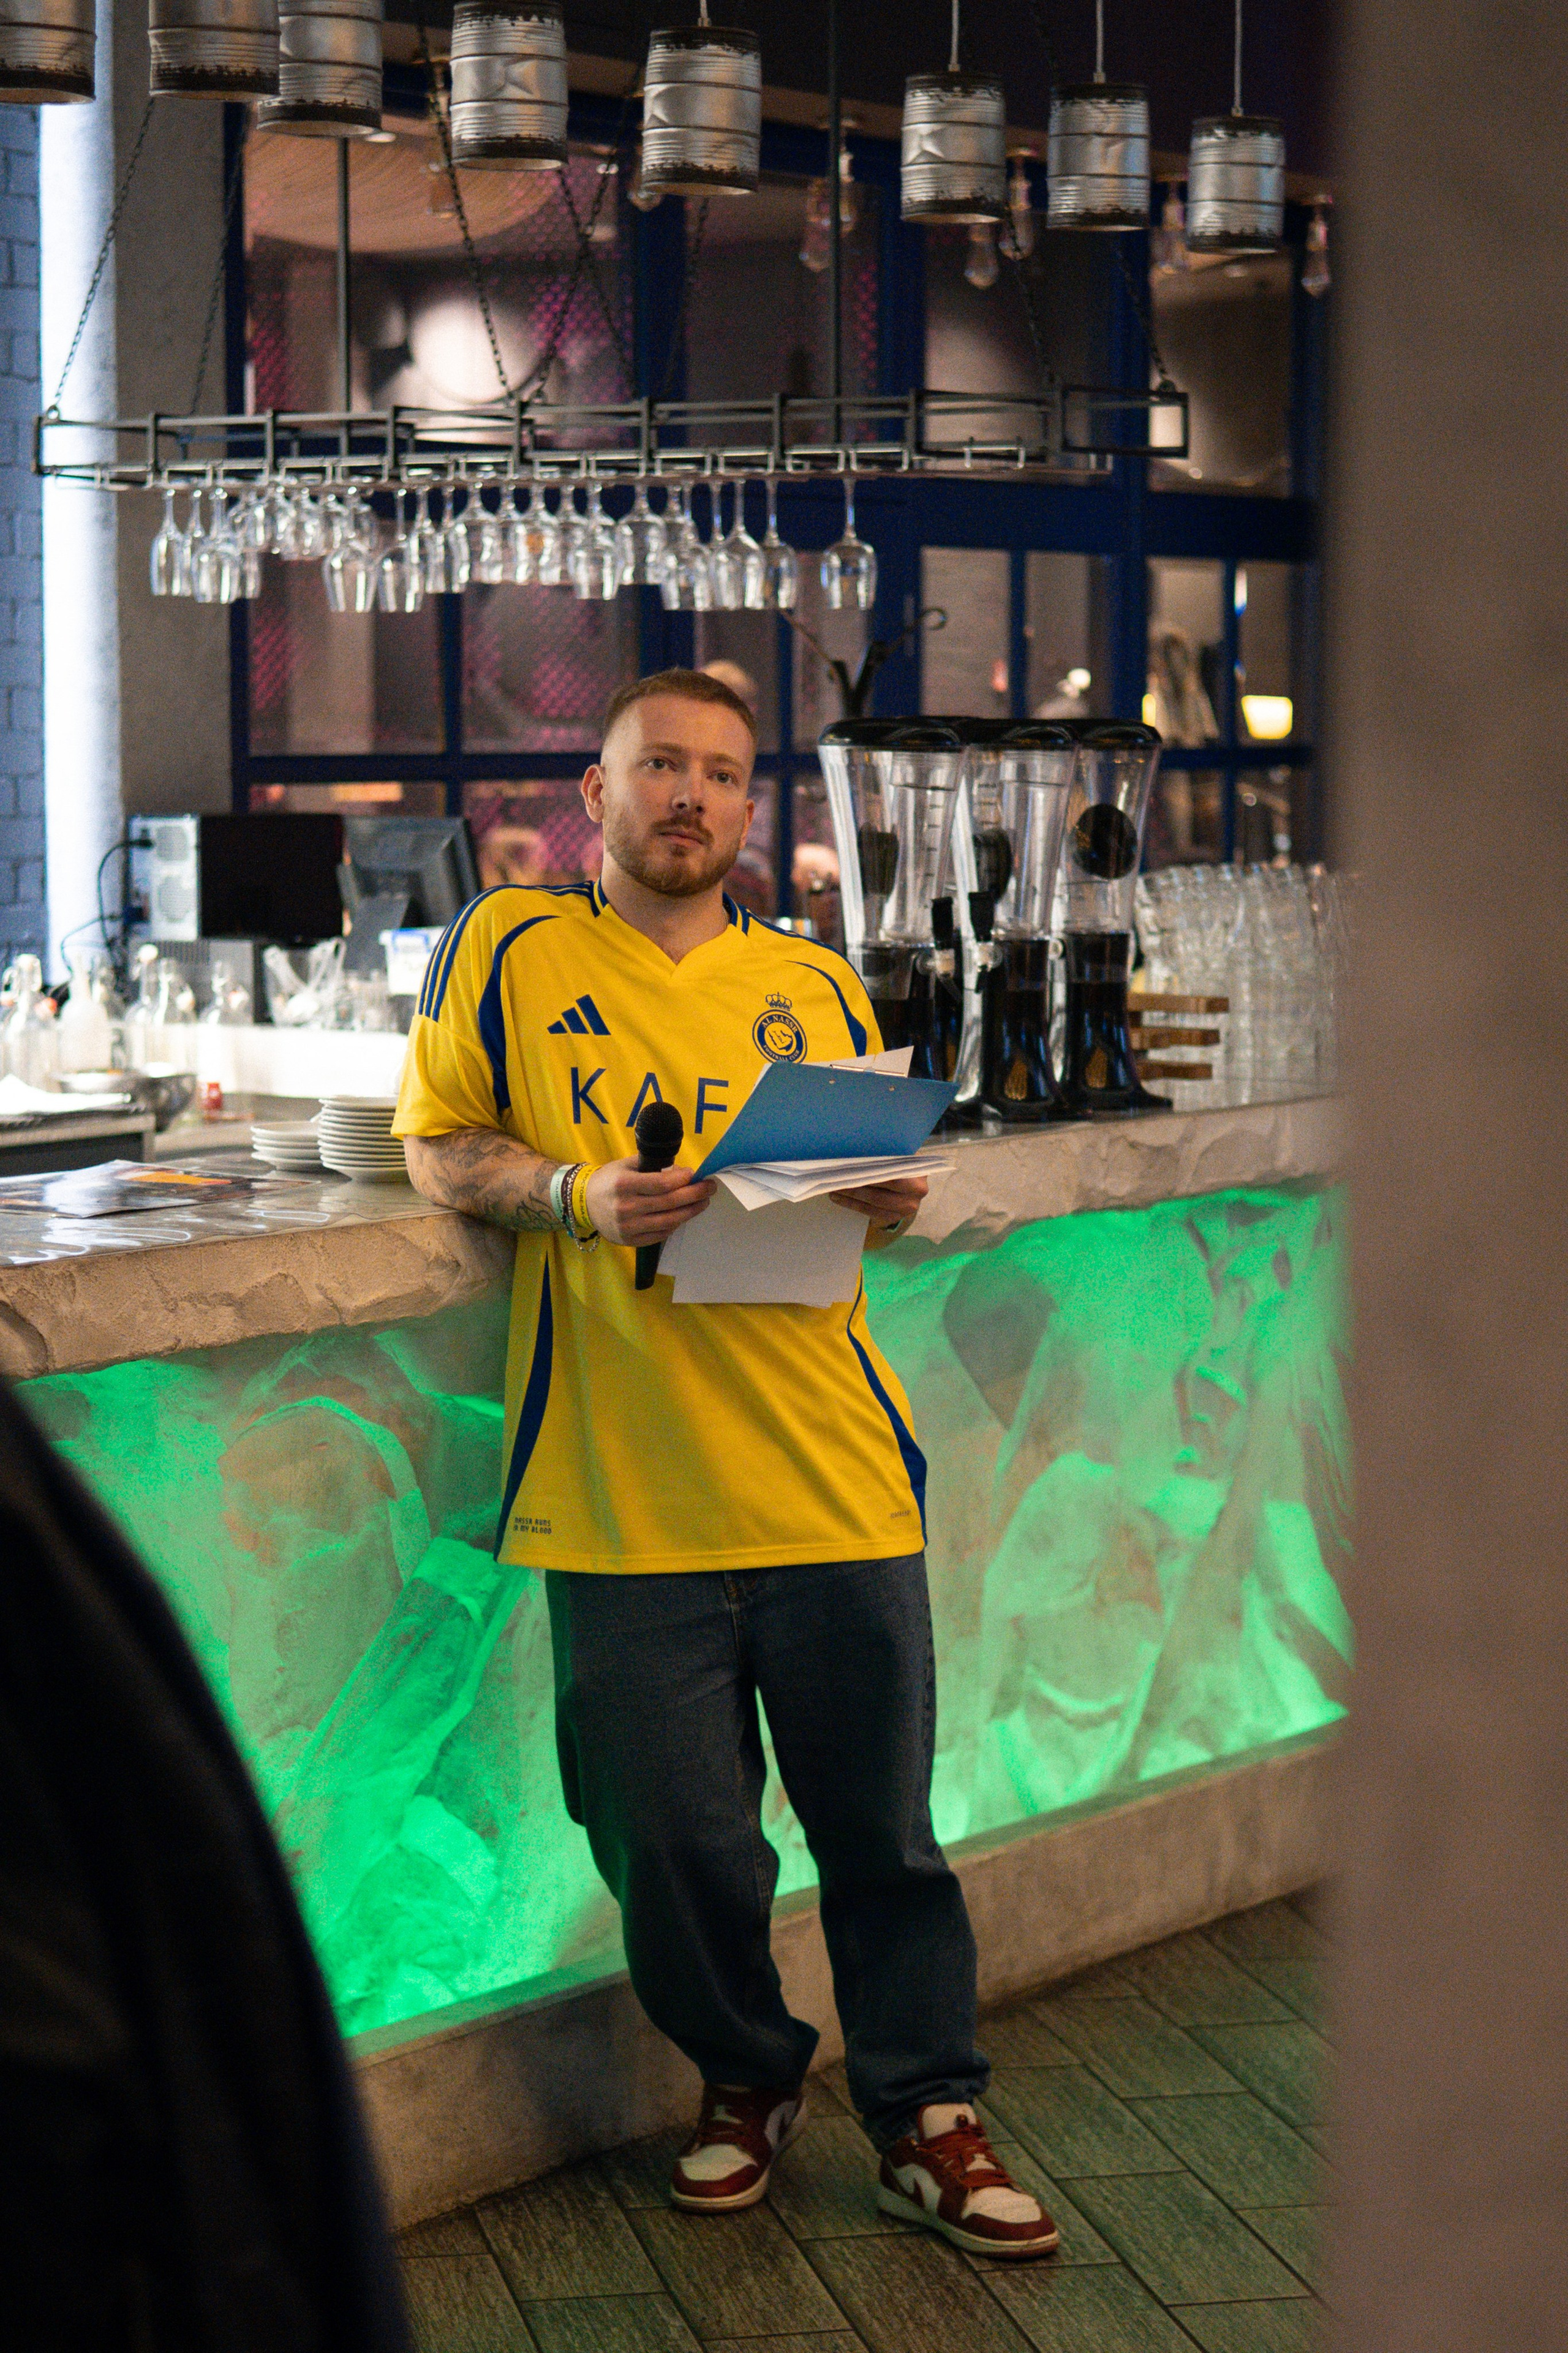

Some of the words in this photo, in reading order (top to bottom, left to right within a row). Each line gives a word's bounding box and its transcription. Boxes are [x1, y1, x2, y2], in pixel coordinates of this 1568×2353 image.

[762, 1018, 772, 1028] AL
[772, 1015, 798, 1033] NASSR
[763, 1044, 788, 1061] FOOTBALL
[790, 1049, 800, 1060] CLUB
